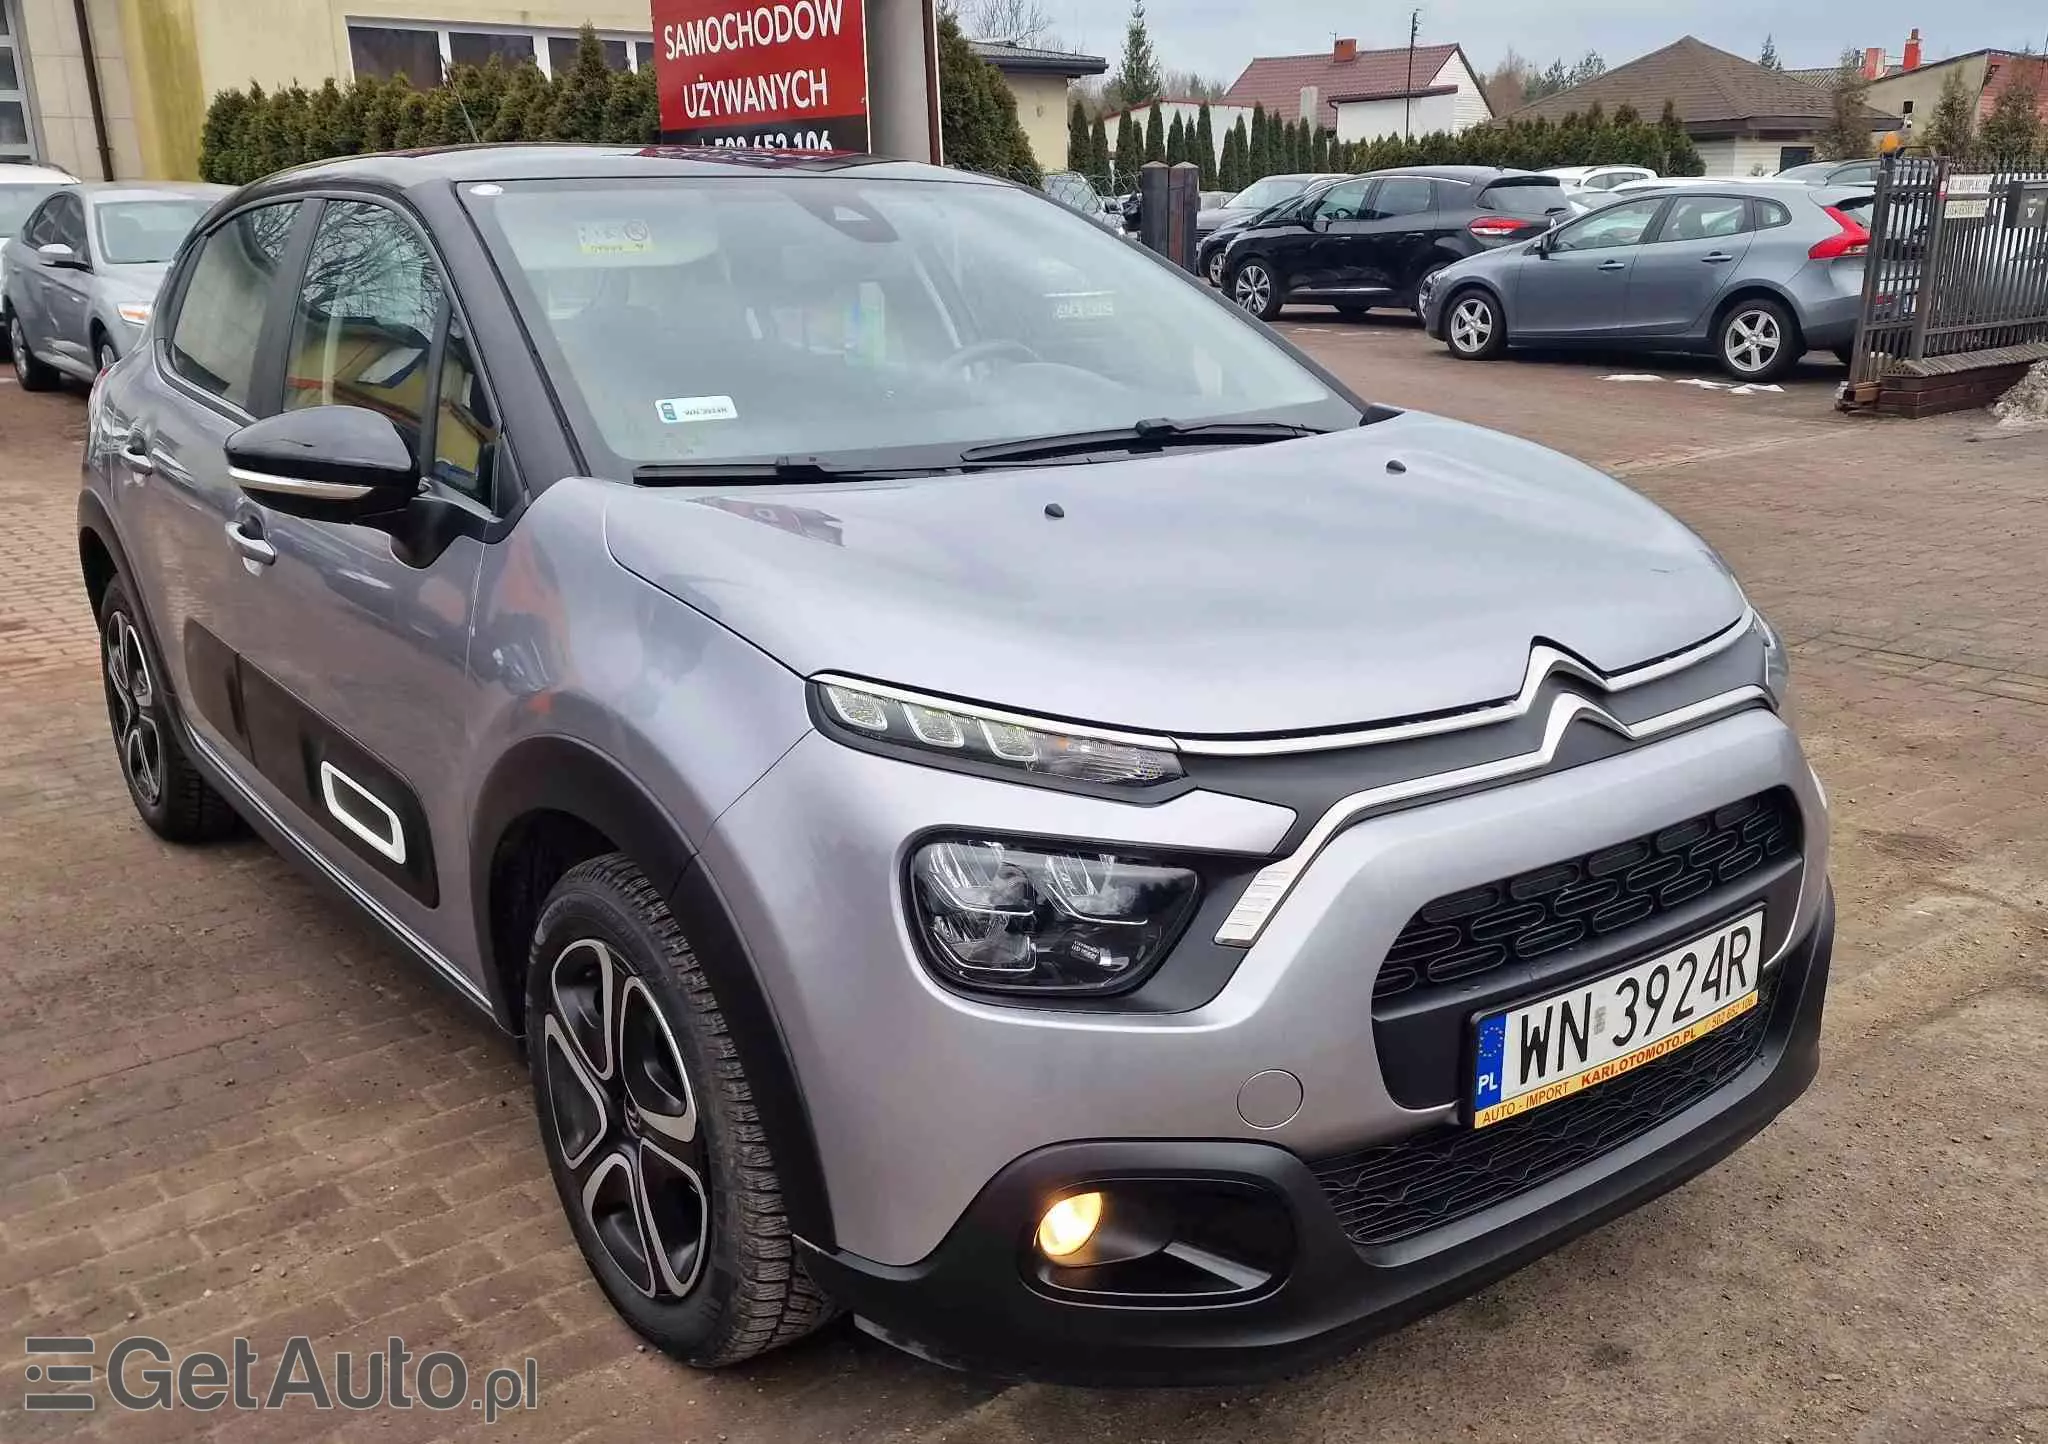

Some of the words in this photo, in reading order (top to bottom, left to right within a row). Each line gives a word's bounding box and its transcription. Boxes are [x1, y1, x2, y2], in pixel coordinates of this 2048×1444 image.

[683, 68, 828, 119] UŻYWANYCH
[793, 130, 833, 152] 106
[1519, 991, 1592, 1086] WN
[1612, 925, 1752, 1047] 3924R
[1477, 1071, 1498, 1095] PL
[1482, 1102, 1515, 1124] AUTO
[1526, 1081, 1569, 1107] IMPORT
[1581, 1027, 1696, 1087] KARI.OTOMOTO.PL
